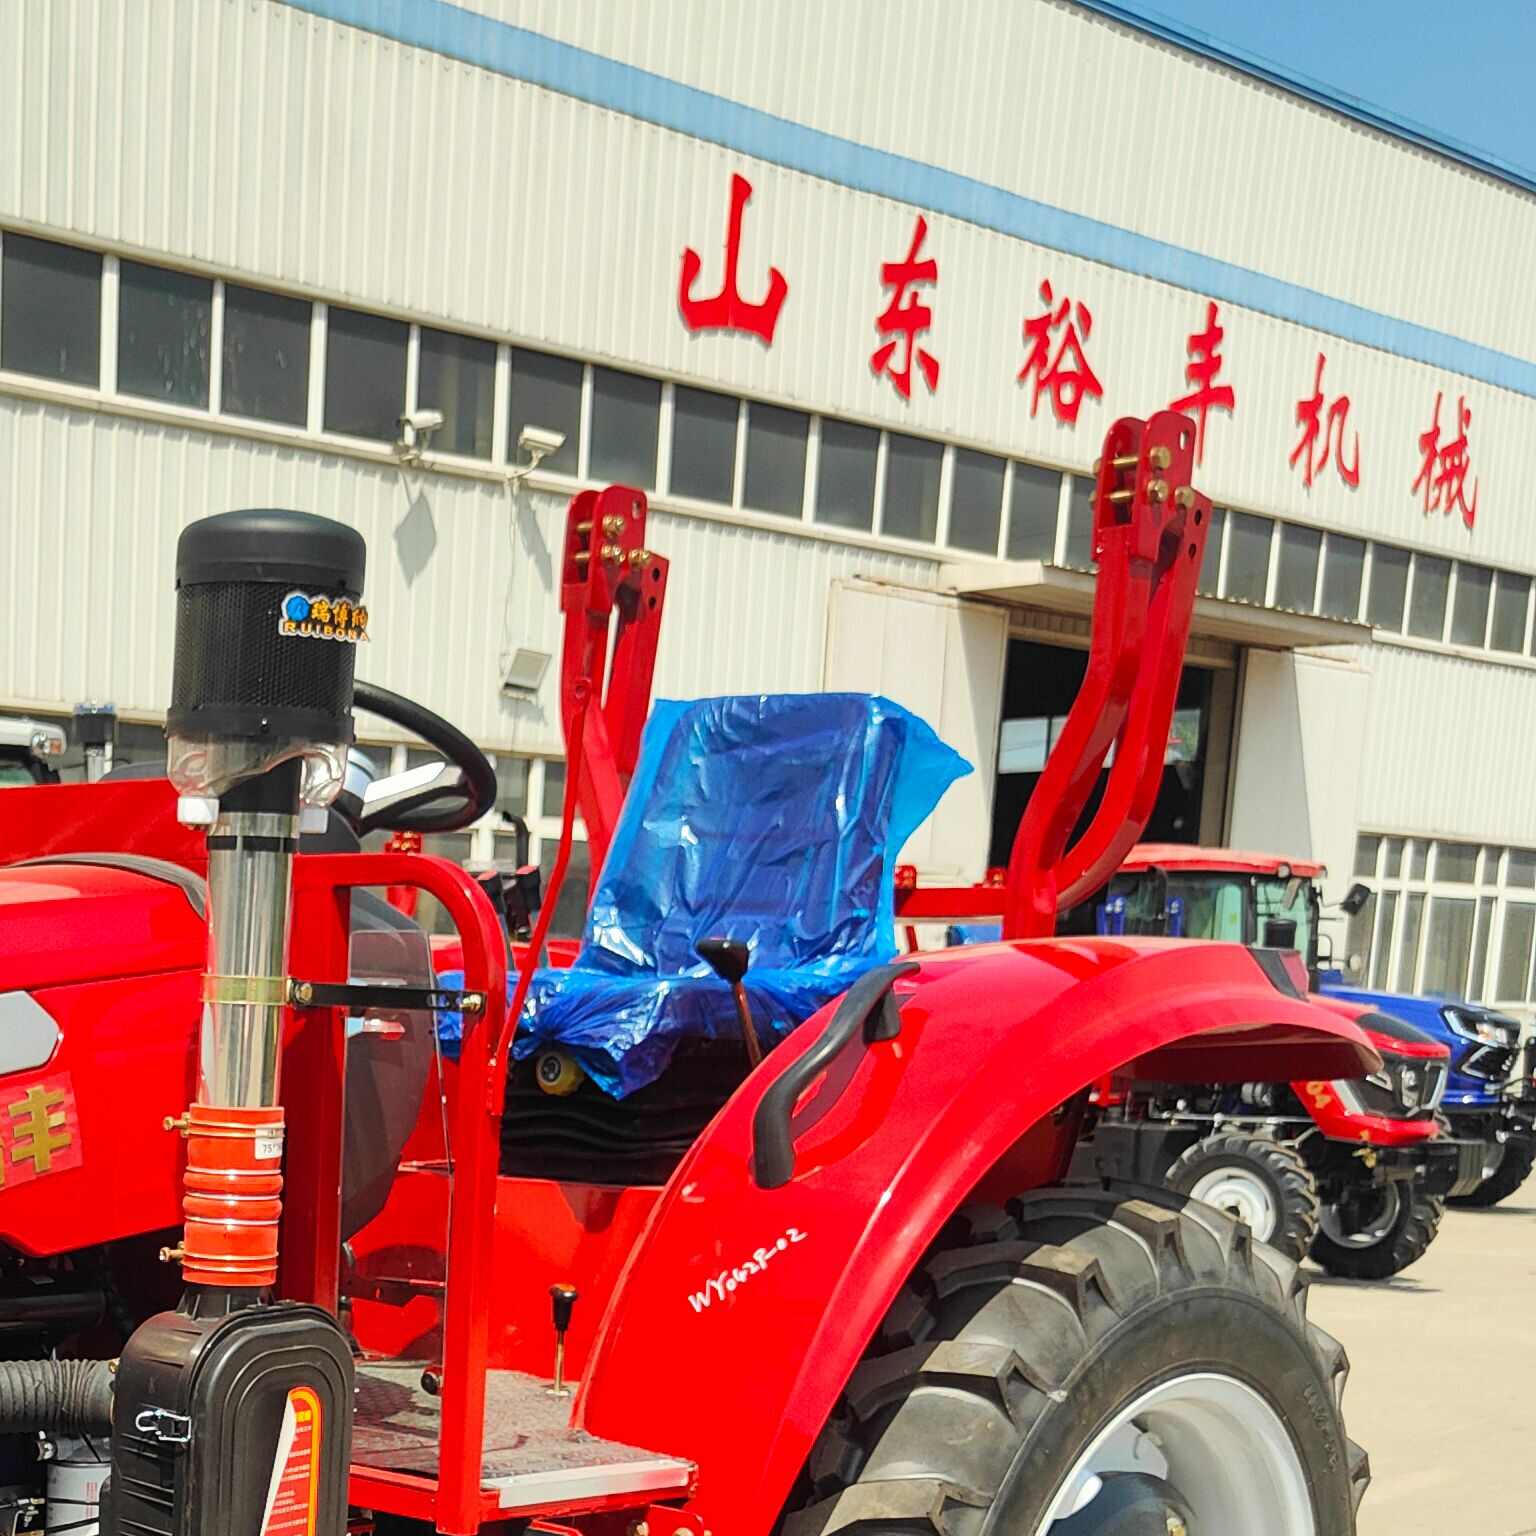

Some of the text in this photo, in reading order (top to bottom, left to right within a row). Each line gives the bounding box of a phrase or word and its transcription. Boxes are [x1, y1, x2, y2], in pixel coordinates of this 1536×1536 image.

[677, 170, 1478, 530] 山东裕丰机械
